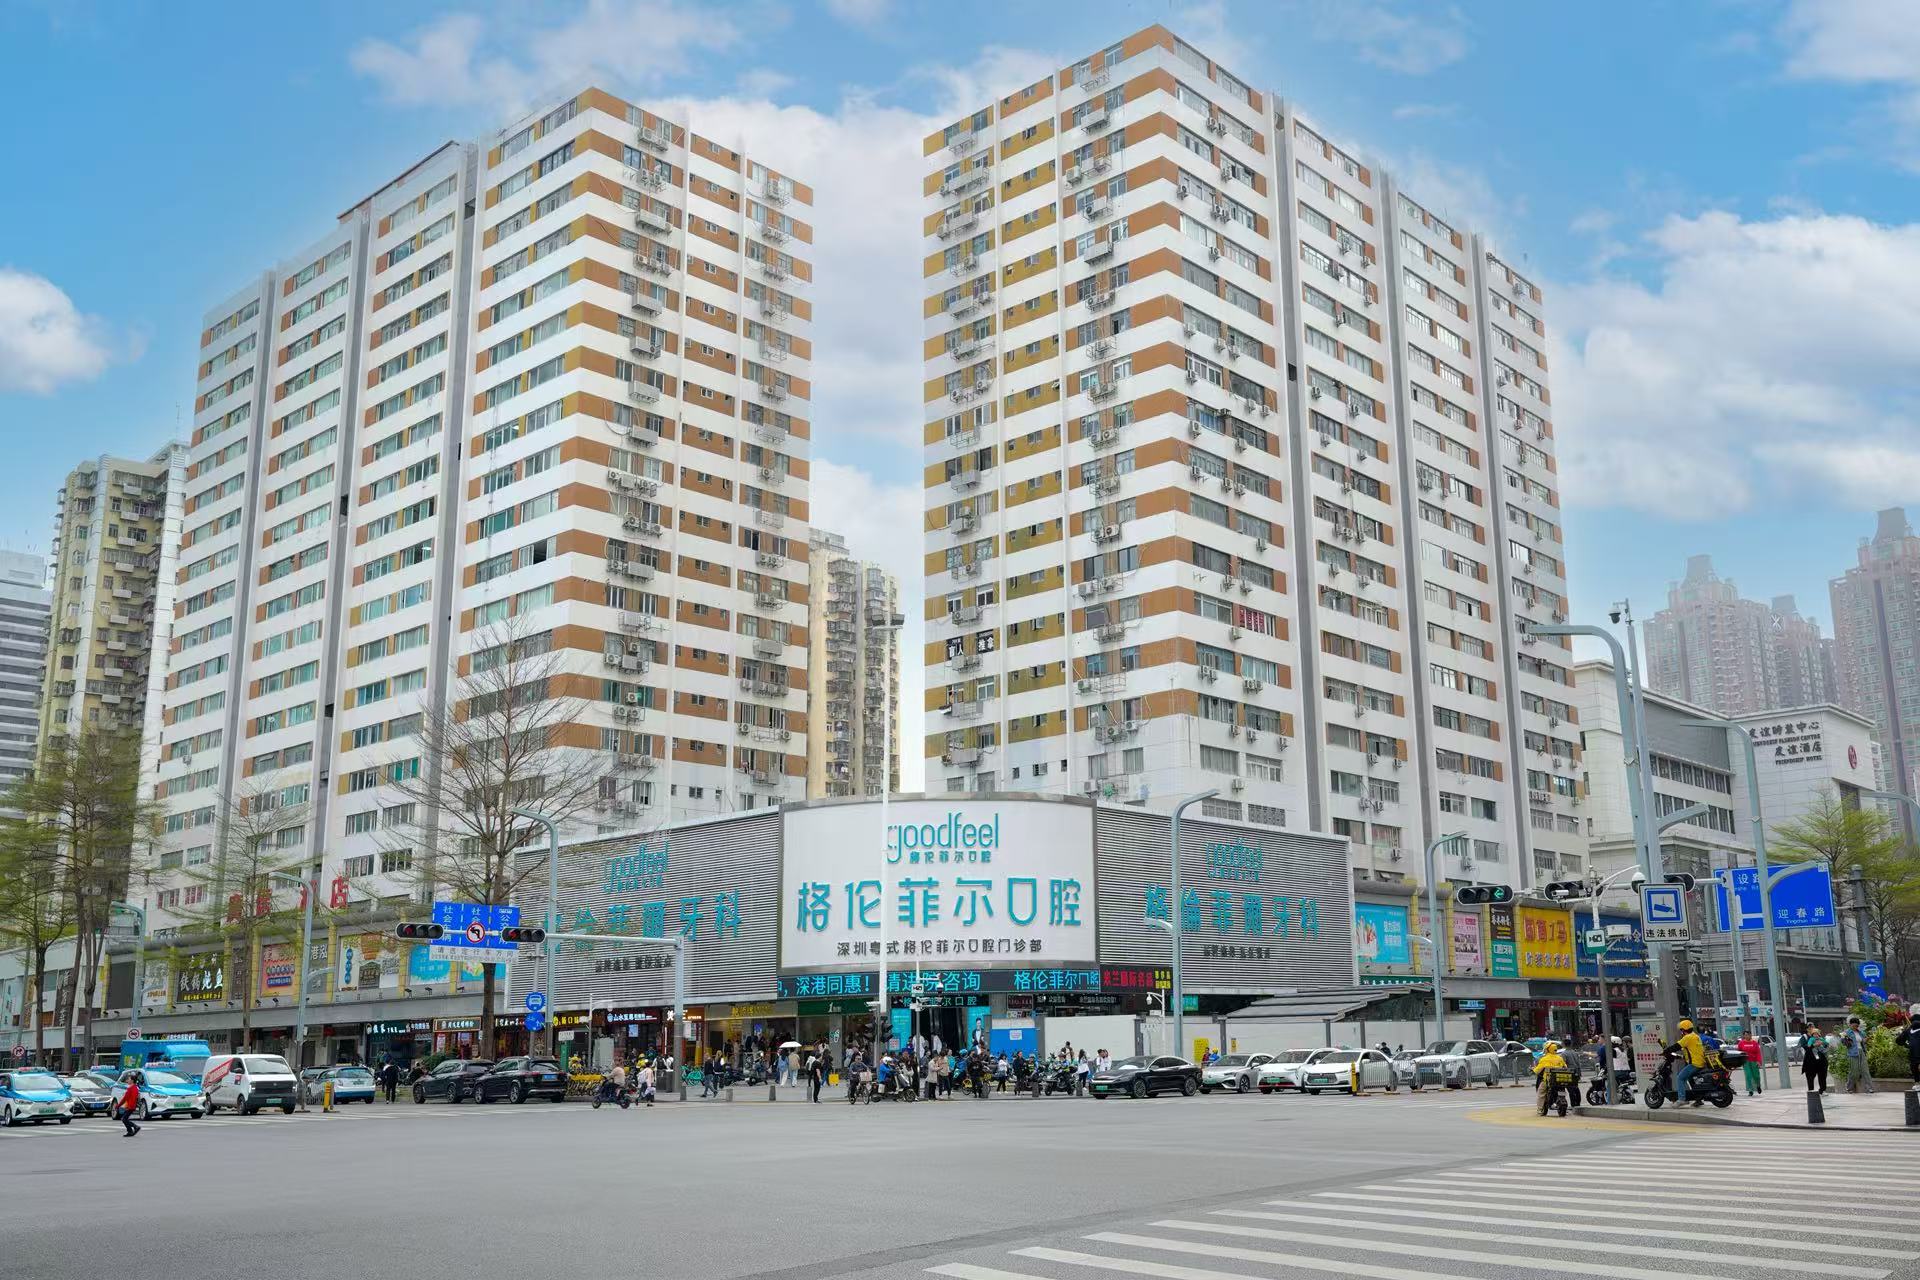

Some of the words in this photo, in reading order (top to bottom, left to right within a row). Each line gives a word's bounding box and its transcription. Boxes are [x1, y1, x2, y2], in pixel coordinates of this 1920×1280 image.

[886, 811, 999, 863] goodfeel
[796, 876, 1082, 933] 格伦菲尔口腔
[1778, 906, 1825, 919] 迎春路
[1645, 928, 1688, 938] 违法抓拍
[837, 938, 1043, 957] 深圳粤式格伦菲尔口腔门诊部
[903, 996, 977, 1007] 格菲尔口腔
